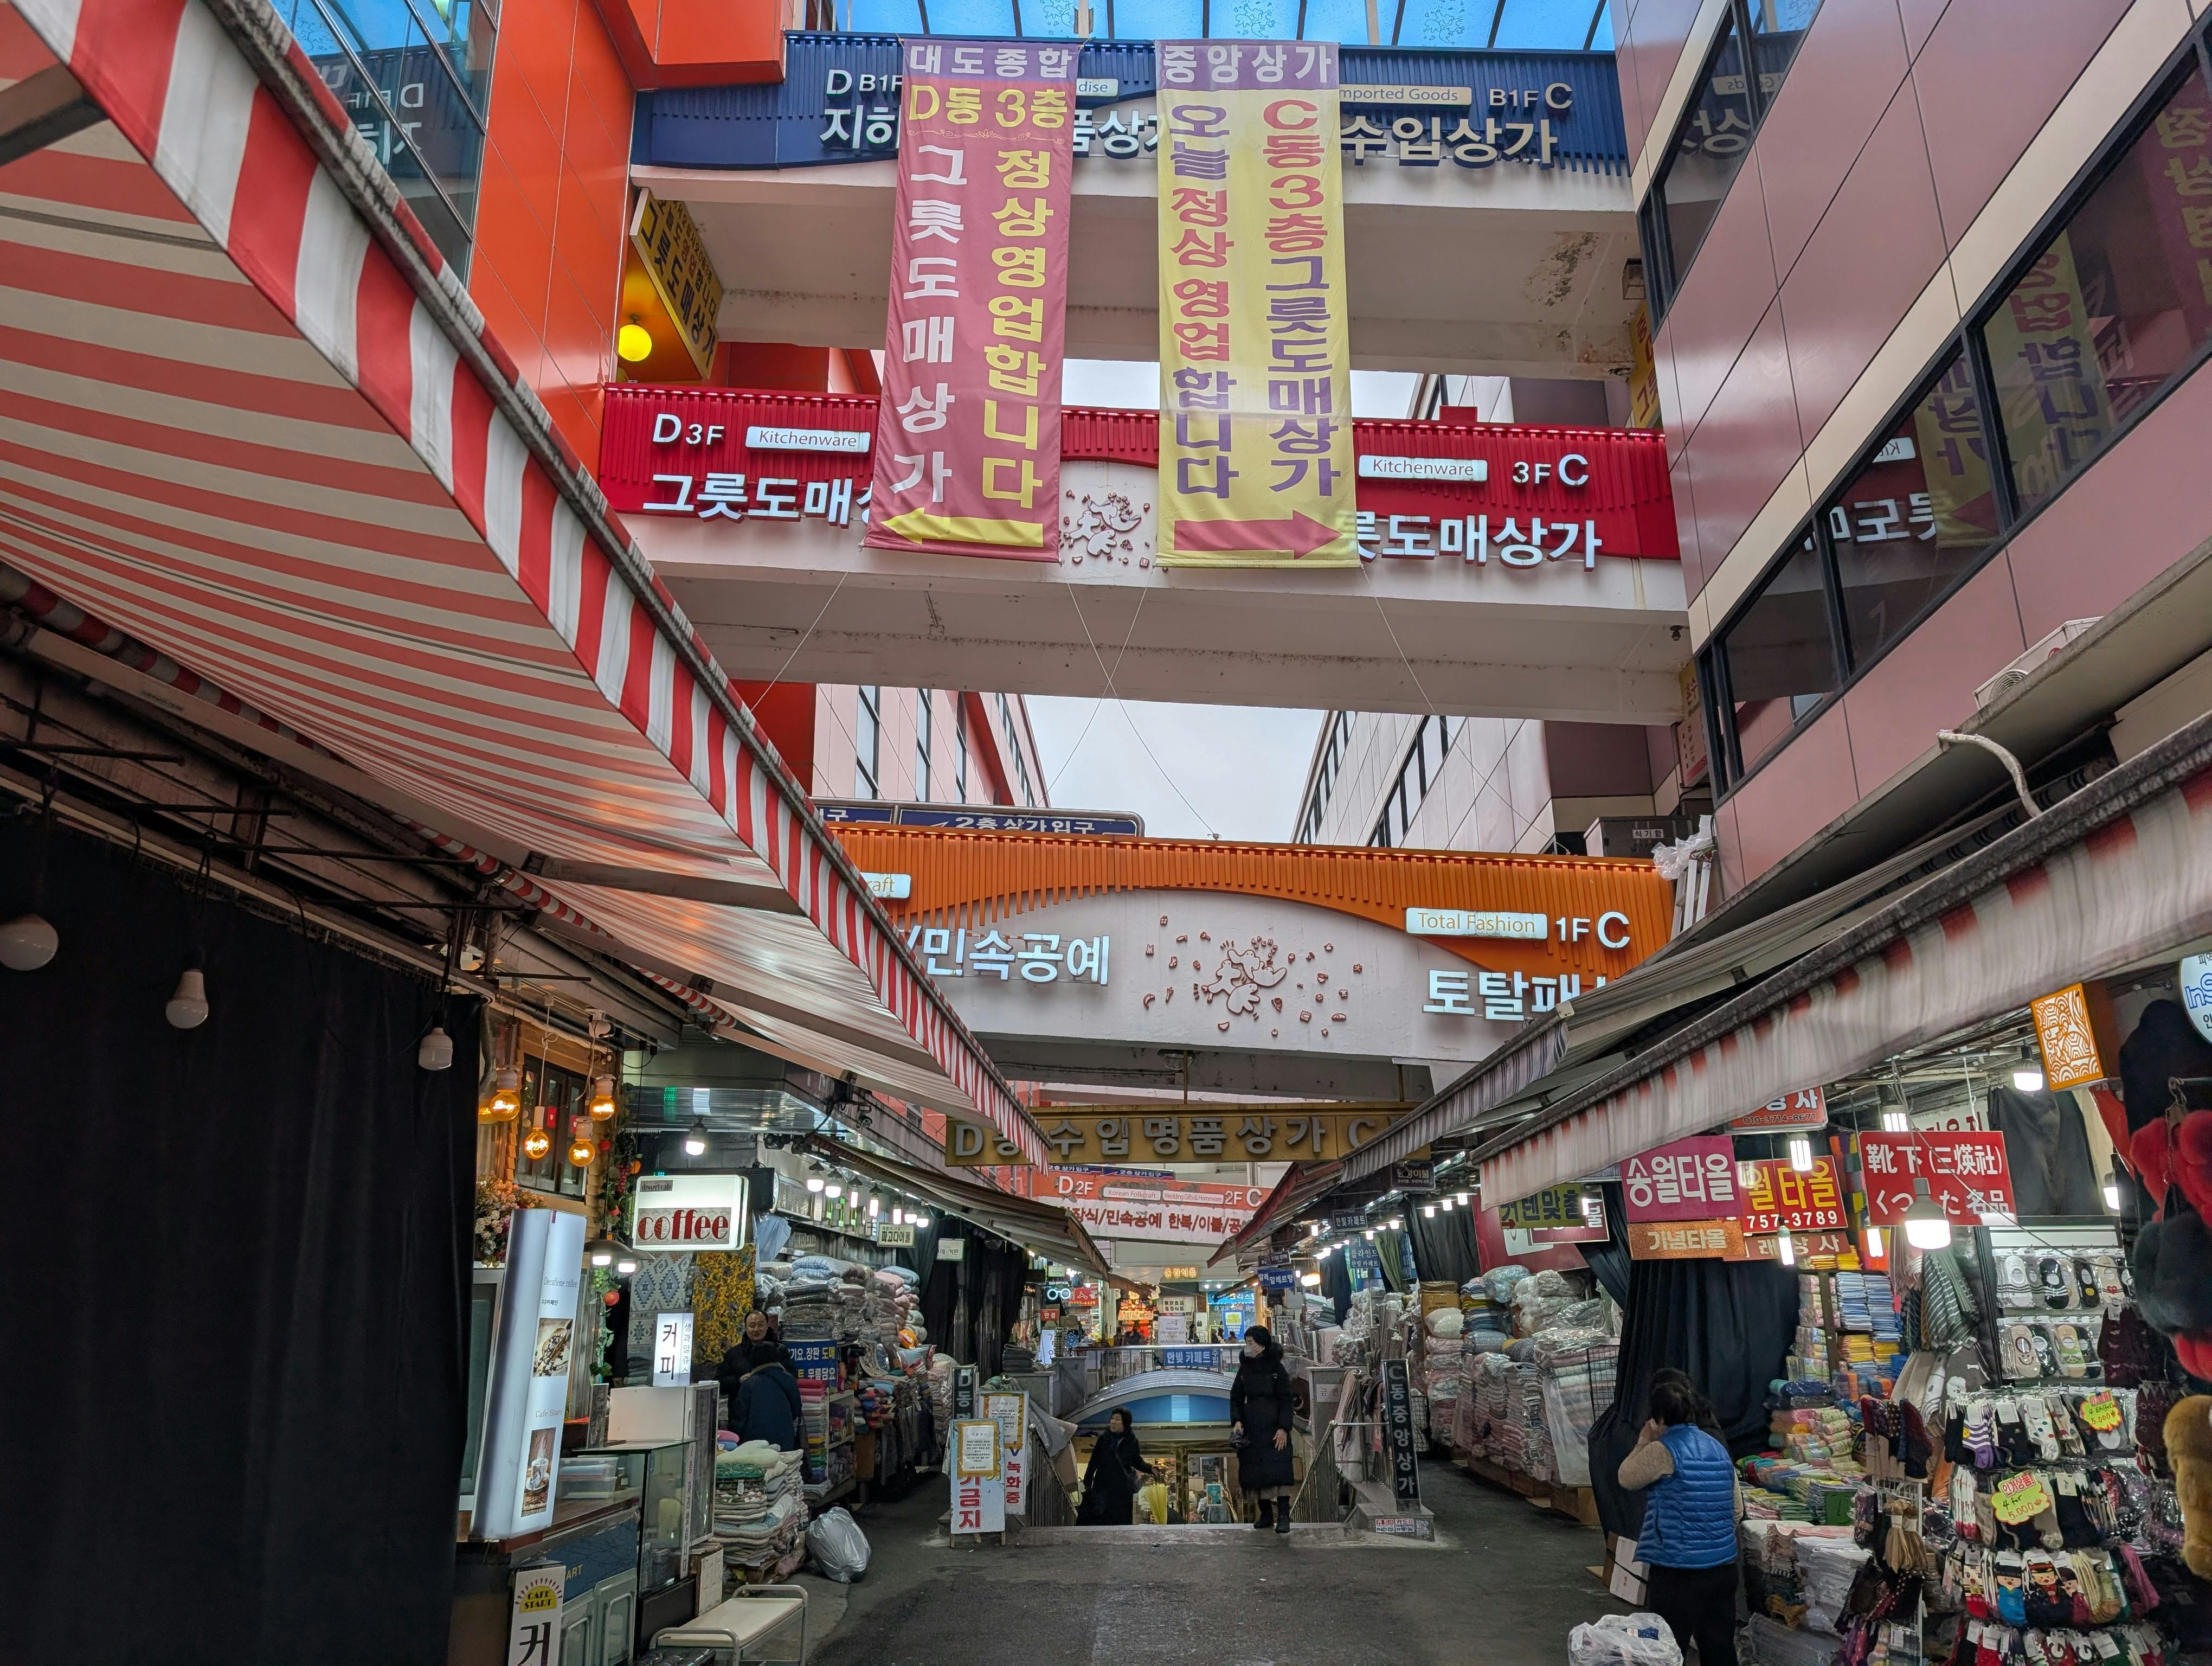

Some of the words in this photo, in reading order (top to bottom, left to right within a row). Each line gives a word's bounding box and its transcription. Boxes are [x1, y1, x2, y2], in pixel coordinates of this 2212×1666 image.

[910, 46, 1072, 78] 대도종합
[1165, 45, 1332, 83] 중앙상가
[826, 69, 852, 94] D
[1339, 86, 1405, 101] mported
[1409, 87, 1457, 101] Goods
[1490, 89, 1538, 108] B1F
[1545, 82, 1573, 108] C
[910, 85, 983, 125] D동
[996, 89, 1068, 129] 3층
[1342, 118, 1559, 168] 수입상가
[890, 145, 967, 503] 그릇도매상가
[652, 414, 681, 443] D
[685, 424, 725, 445] 3F
[758, 430, 857, 448] Kitchenware
[1373, 459, 1474, 476] Kitchenware
[1513, 462, 1552, 484] 3F
[1559, 454, 1589, 486] C
[642, 472, 873, 527] 그릇도매
[1417, 913, 1460, 930] Total
[1467, 915, 1535, 933] Fashion
[1555, 917, 1590, 942] 1F
[1598, 912, 1630, 949] C
[1422, 970, 1605, 1021] 토탈패
[1744, 1113, 1816, 1124] 010-3714-8671
[1049, 1116, 1326, 1156] 수입명품상가
[1058, 1176, 1073, 1194] D
[1076, 1182, 1094, 1194] 2F
[1165, 1193, 1183, 1201] Wedding
[1224, 1191, 1242, 1205] 2F
[1246, 1189, 1262, 1207] C
[1626, 1153, 1734, 1206] 송월타올
[1877, 1189, 2009, 1215] くつた名品
[638, 1209, 728, 1240] coffee
[1746, 1210, 1837, 1229] 757-3789
[1351, 1248, 1378, 1258] 블라인드
[1648, 1228, 1727, 1251] 기념타올
[1745, 1234, 1839, 1258] 래상사
[566, 1279, 577, 1287] coffee
[1164, 1267, 1197, 1278] 동경식품
[1270, 1274, 1293, 1285] 알레르망
[660, 1323, 677, 1380] 커피
[681, 1323, 691, 1374] 생과일쥬스
[1167, 1352, 1183, 1363] 한빛
[1186, 1350, 1211, 1363] 카페트
[1006, 1461, 1021, 1504] 녹화중
[2011, 1494, 2023, 1504] for
[524, 1599, 552, 1610] START
[528, 1590, 551, 1600] CAFE
